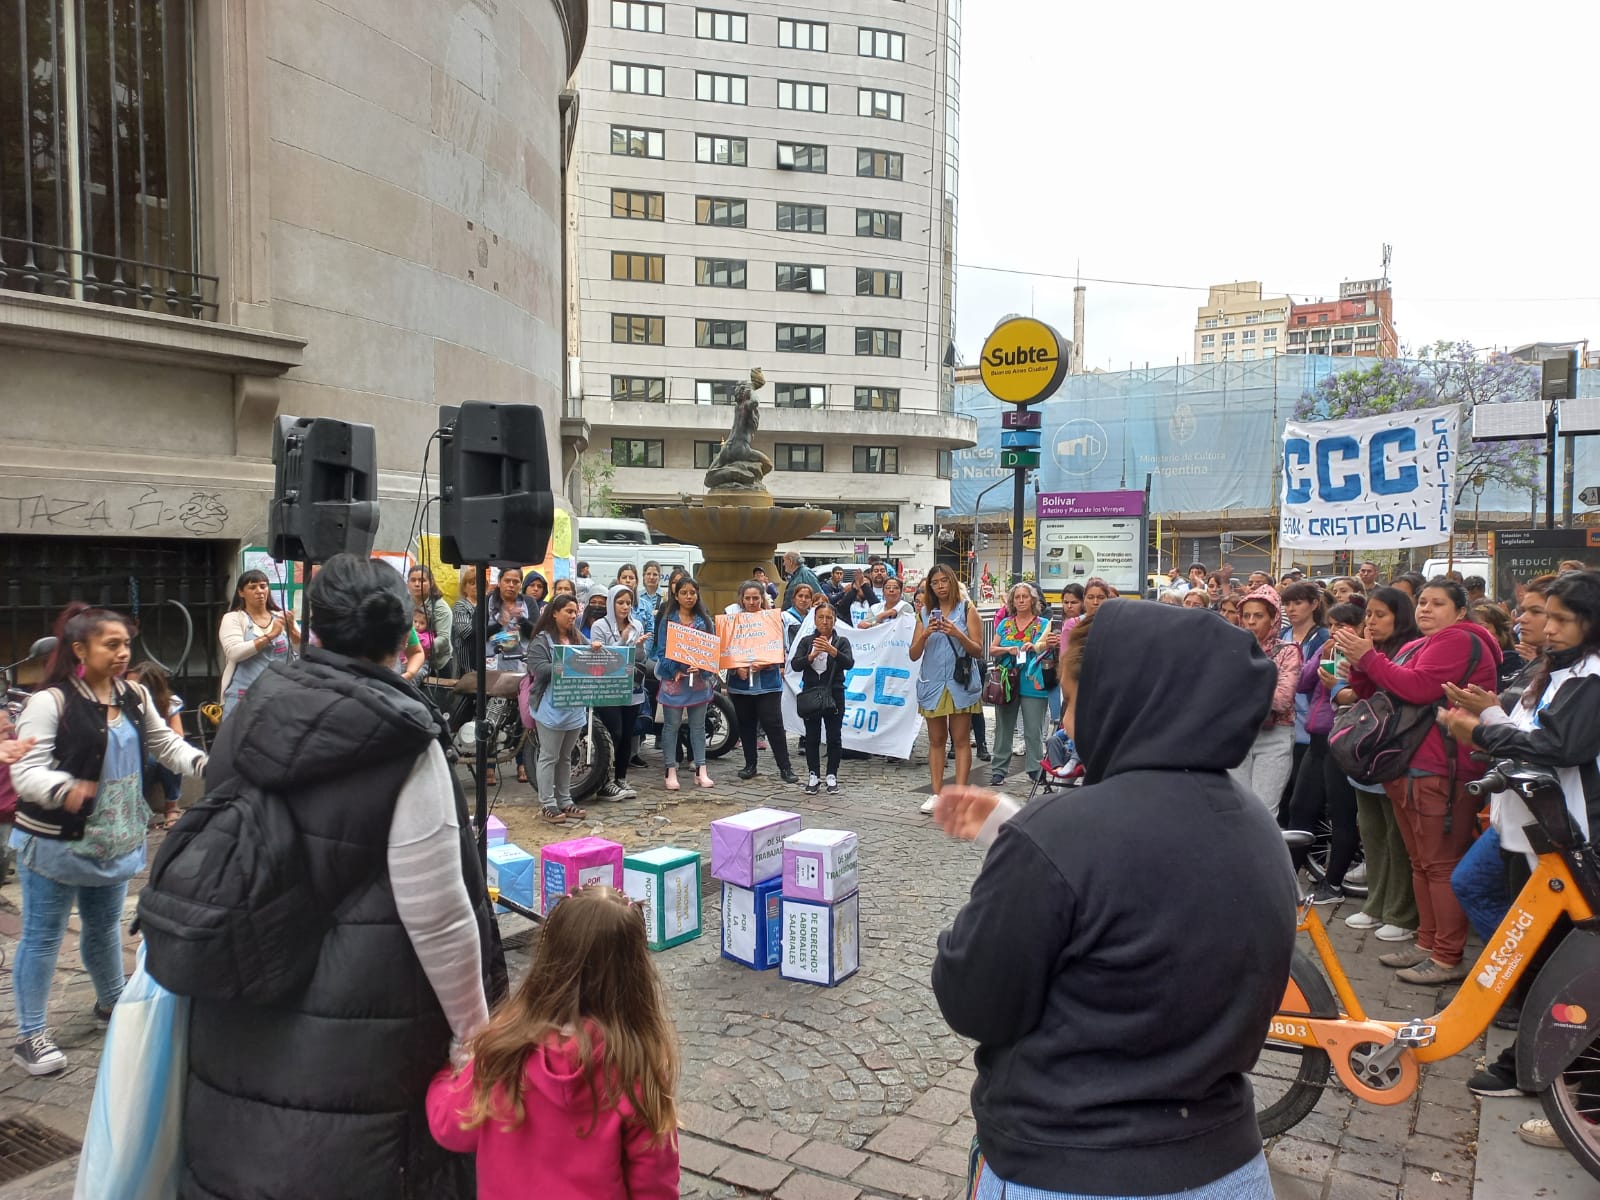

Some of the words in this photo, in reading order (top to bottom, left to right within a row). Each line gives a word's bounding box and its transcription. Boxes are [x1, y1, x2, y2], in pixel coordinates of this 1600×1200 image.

[984, 346, 1057, 367] Subte
[1010, 412, 1017, 424] E
[1008, 432, 1018, 445] A
[1008, 453, 1018, 465] D
[1139, 455, 1180, 463] Ministerio
[1183, 453, 1192, 461] de
[1194, 450, 1226, 461] Cultura
[963, 464, 1013, 479] Nación
[1153, 464, 1208, 477] Argentina
[1284, 426, 1419, 504] CCC
[1431, 418, 1449, 532] CAPITAL
[1308, 512, 1426, 536] CRISTOBAL
[1511, 557, 1552, 566] REDUCÍ
[733, 916, 739, 926] LA
[811, 912, 818, 923] DE
[799, 912, 807, 963] LABORALES
[1490, 909, 1535, 966] Ecobici
[810, 927, 818, 974] DERECHOS
[1553, 1022, 1587, 1030] mastercard
